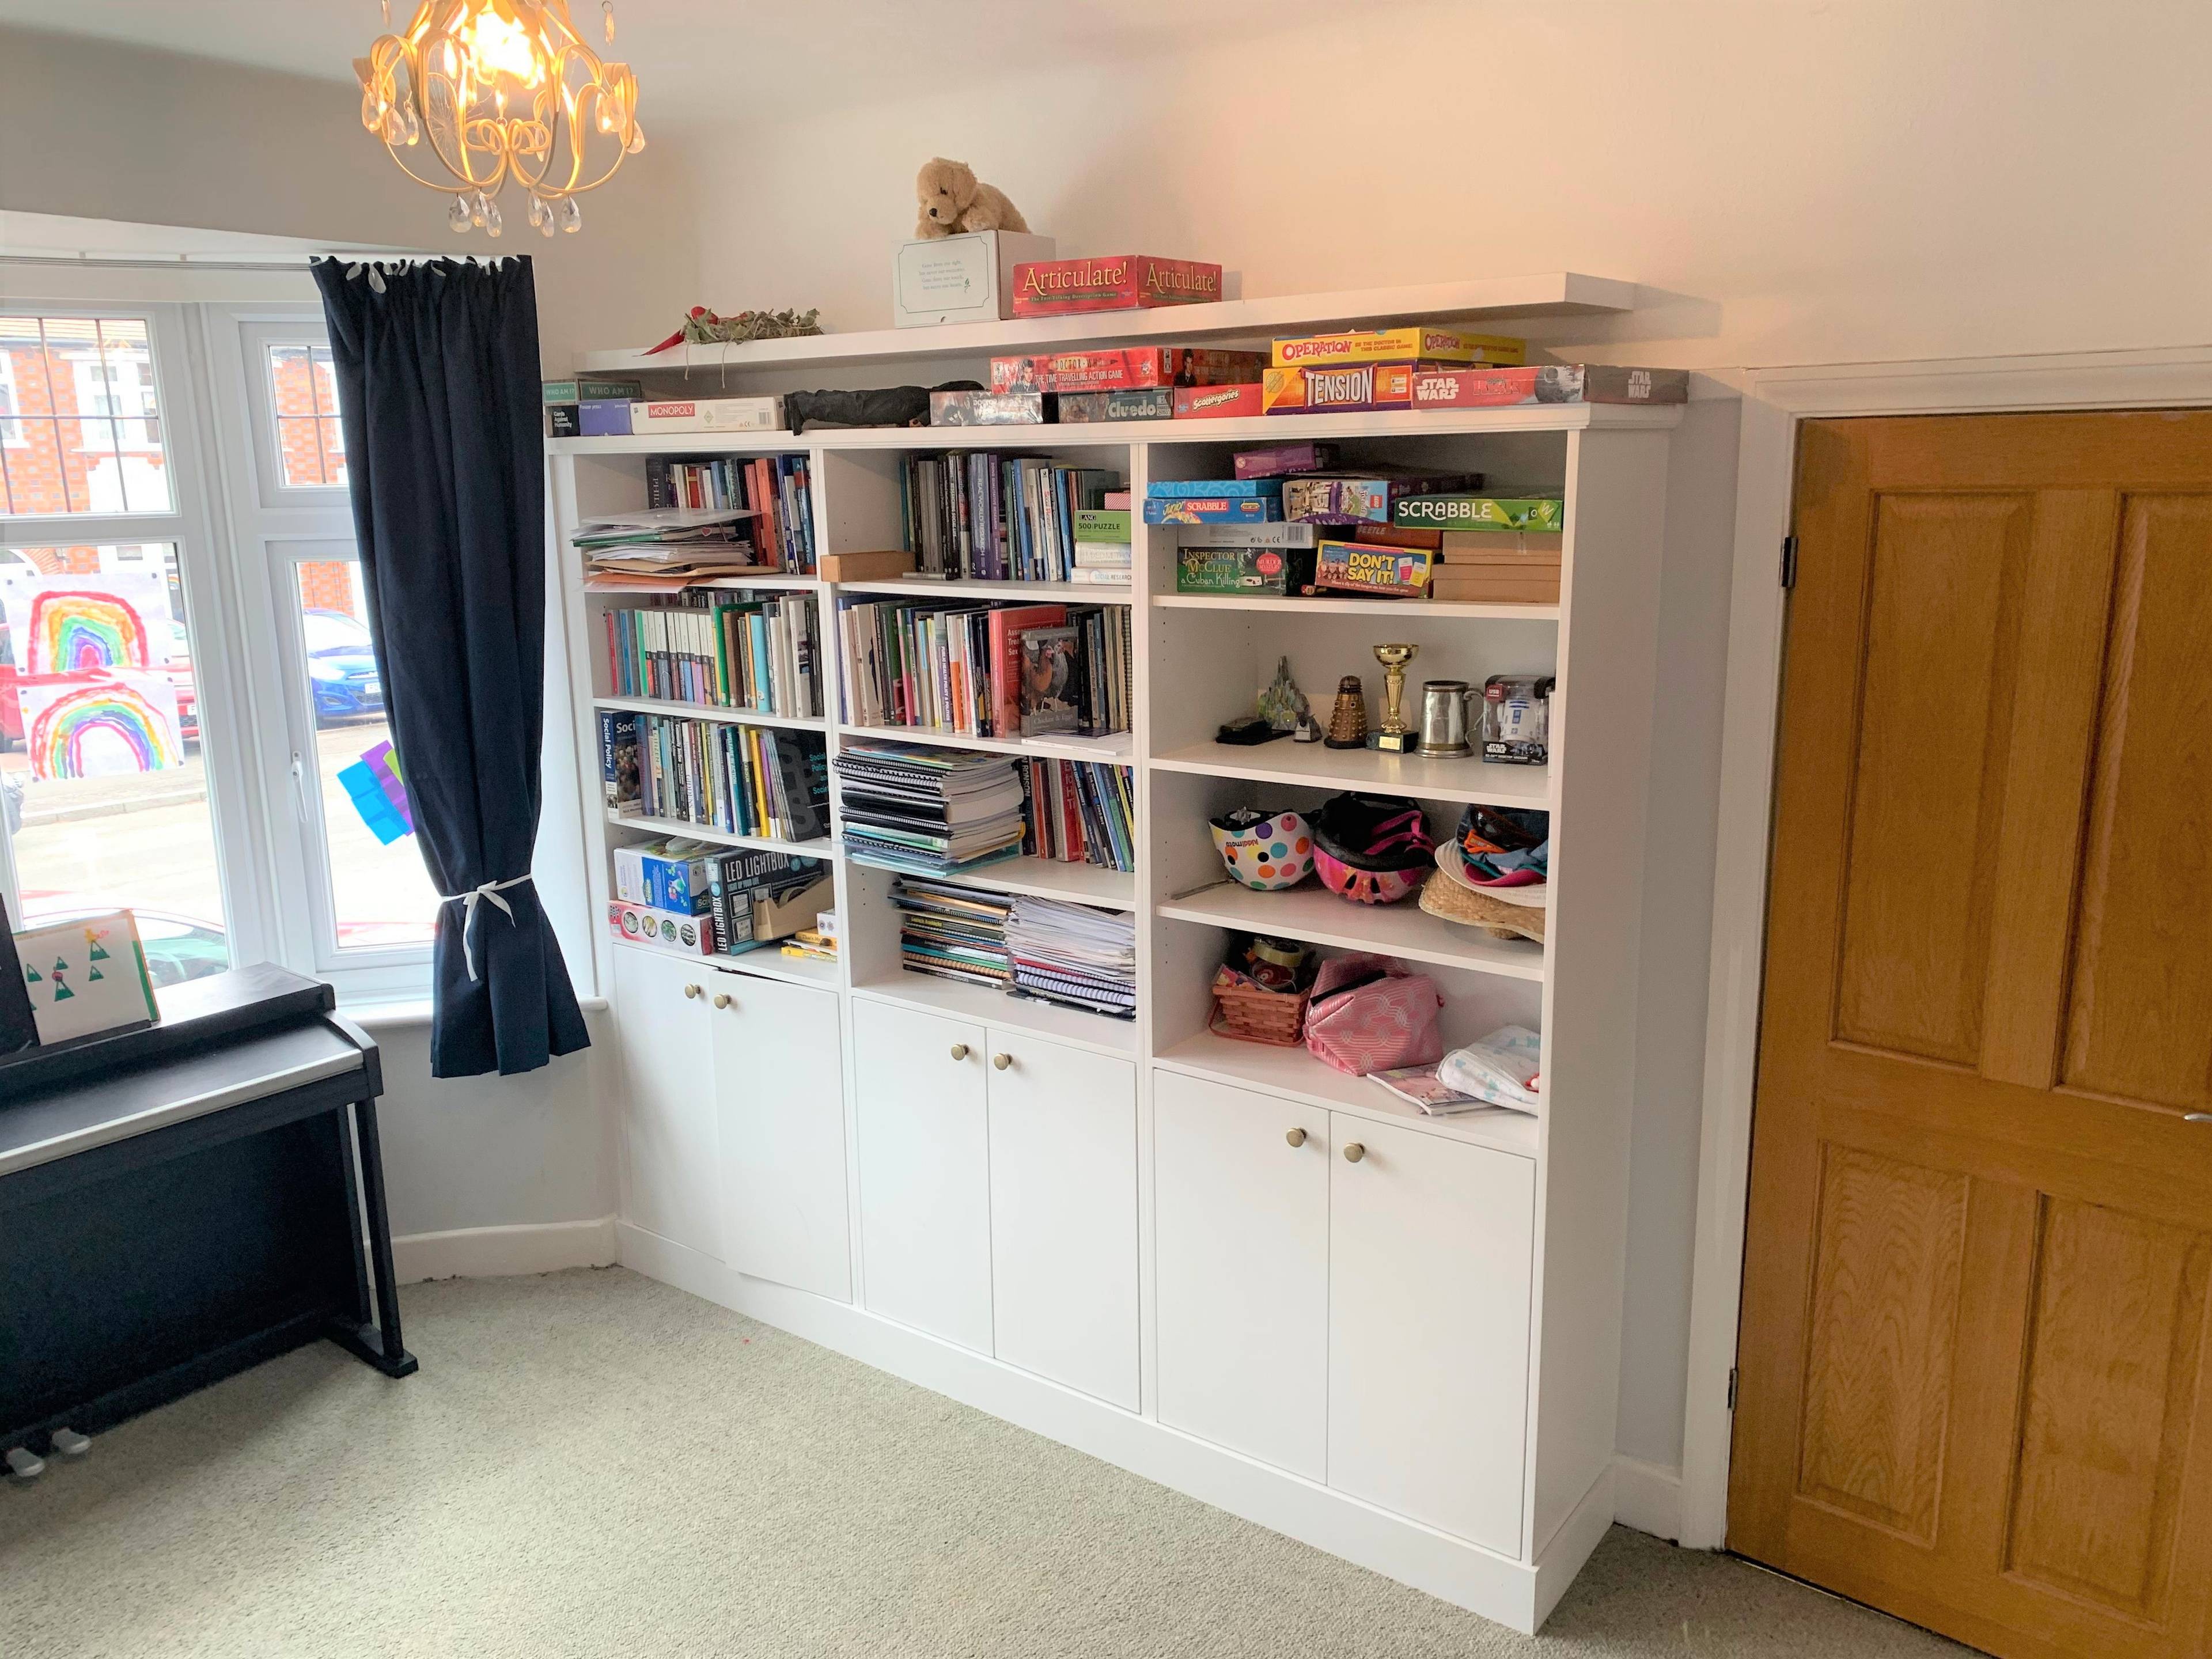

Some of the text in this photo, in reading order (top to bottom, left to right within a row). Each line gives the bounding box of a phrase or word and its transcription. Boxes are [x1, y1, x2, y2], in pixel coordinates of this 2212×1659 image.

[1022, 260, 1127, 296] Articulate!
[1146, 263, 1217, 294] Articulate!
[1282, 339, 1353, 361] OPERATION
[1425, 333, 1460, 351] OPERATION
[1055, 358, 1081, 370] DOCTOR
[1035, 369, 1124, 384] THE TIME TRAVELLING ACTION GAME
[1417, 378, 1459, 389] STAR
[1628, 370, 1651, 384] STAR
[589, 387, 634, 395] WHO AM I?
[1305, 368, 1374, 406] TENSION
[1417, 388, 1459, 401] WARS
[1628, 384, 1651, 399] WARS
[1192, 389, 1240, 411] Scattergories
[650, 406, 694, 416] MONOPOLY
[1108, 399, 1157, 418] Cluedo
[1163, 501, 1185, 516] Junior
[1187, 501, 1227, 511] SCRABBLE
[1398, 501, 1493, 521] SCRABBLE
[1357, 525, 1386, 535] BEETLE
[1183, 548, 1236, 560] INSPECTOR
[1349, 552, 1396, 570] DON'T
[1187, 573, 1214, 585] Cuban
[1216, 572, 1241, 588] Killing
[1347, 567, 1395, 585] SAY IT!
[603, 718, 612, 743] Social
[809, 752, 827, 762] Social
[656, 764, 661, 775] 21
[1021, 765, 1031, 797] RONSON
[1225, 838, 1259, 847] kiddimoto
[725, 852, 790, 882] LED LIGHTBOX
[711, 896, 728, 952] LED LIGHTBOX
